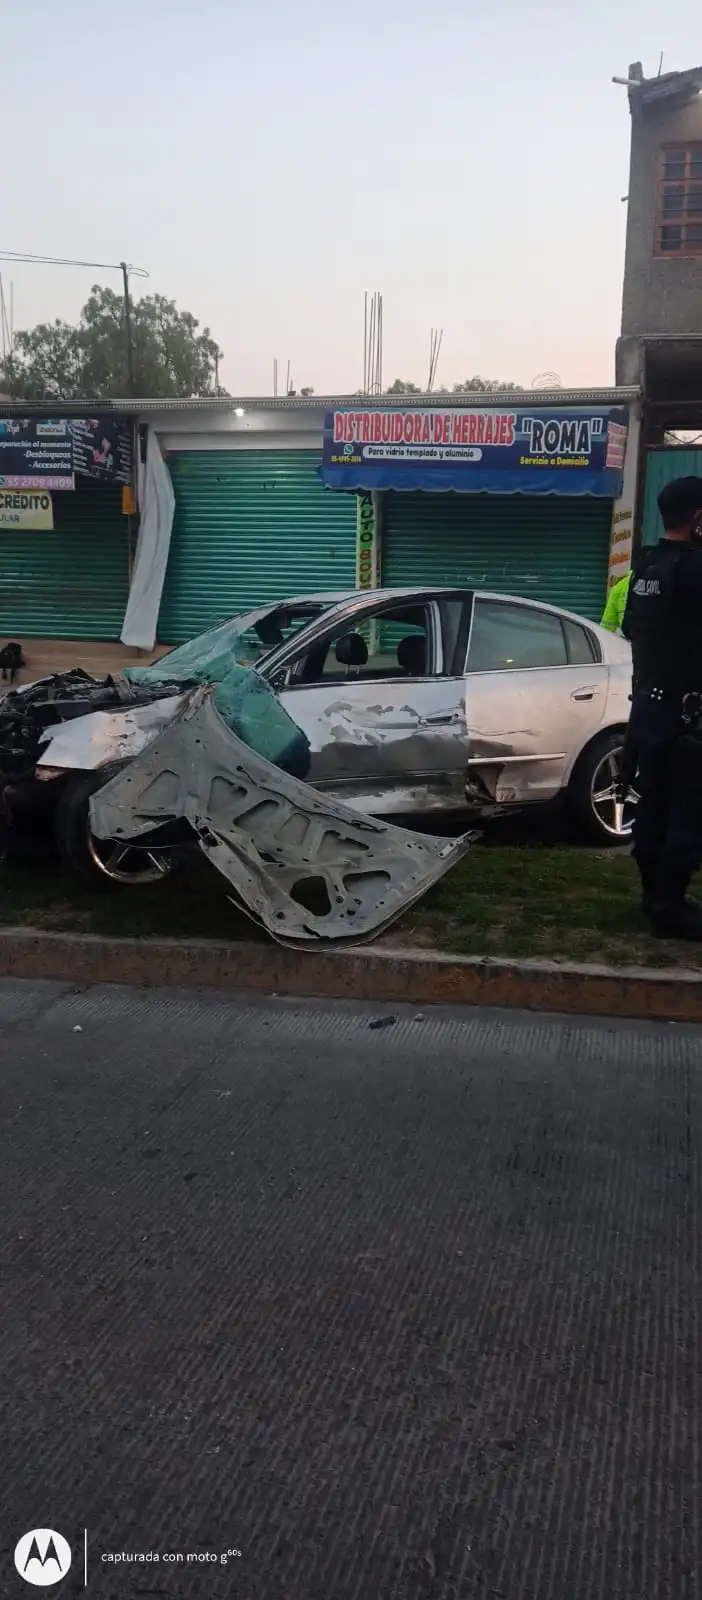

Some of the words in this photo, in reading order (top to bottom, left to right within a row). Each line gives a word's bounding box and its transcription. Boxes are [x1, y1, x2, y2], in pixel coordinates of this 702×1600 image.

[333, 411, 431, 443] DISTRIBUIDORA
[432, 413, 450, 444] DE
[451, 413, 517, 446] HERRAJES
[522, 418, 603, 454] "ROMA"
[368, 447, 384, 456] Para
[386, 447, 405, 456] vidrio
[407, 448, 437, 458] templado
[439, 451, 444, 459] y
[445, 449, 474, 458] aluminio
[520, 456, 548, 465] Servicio
[556, 457, 589, 466] Domicilio
[360, 491, 373, 543] AUTO
